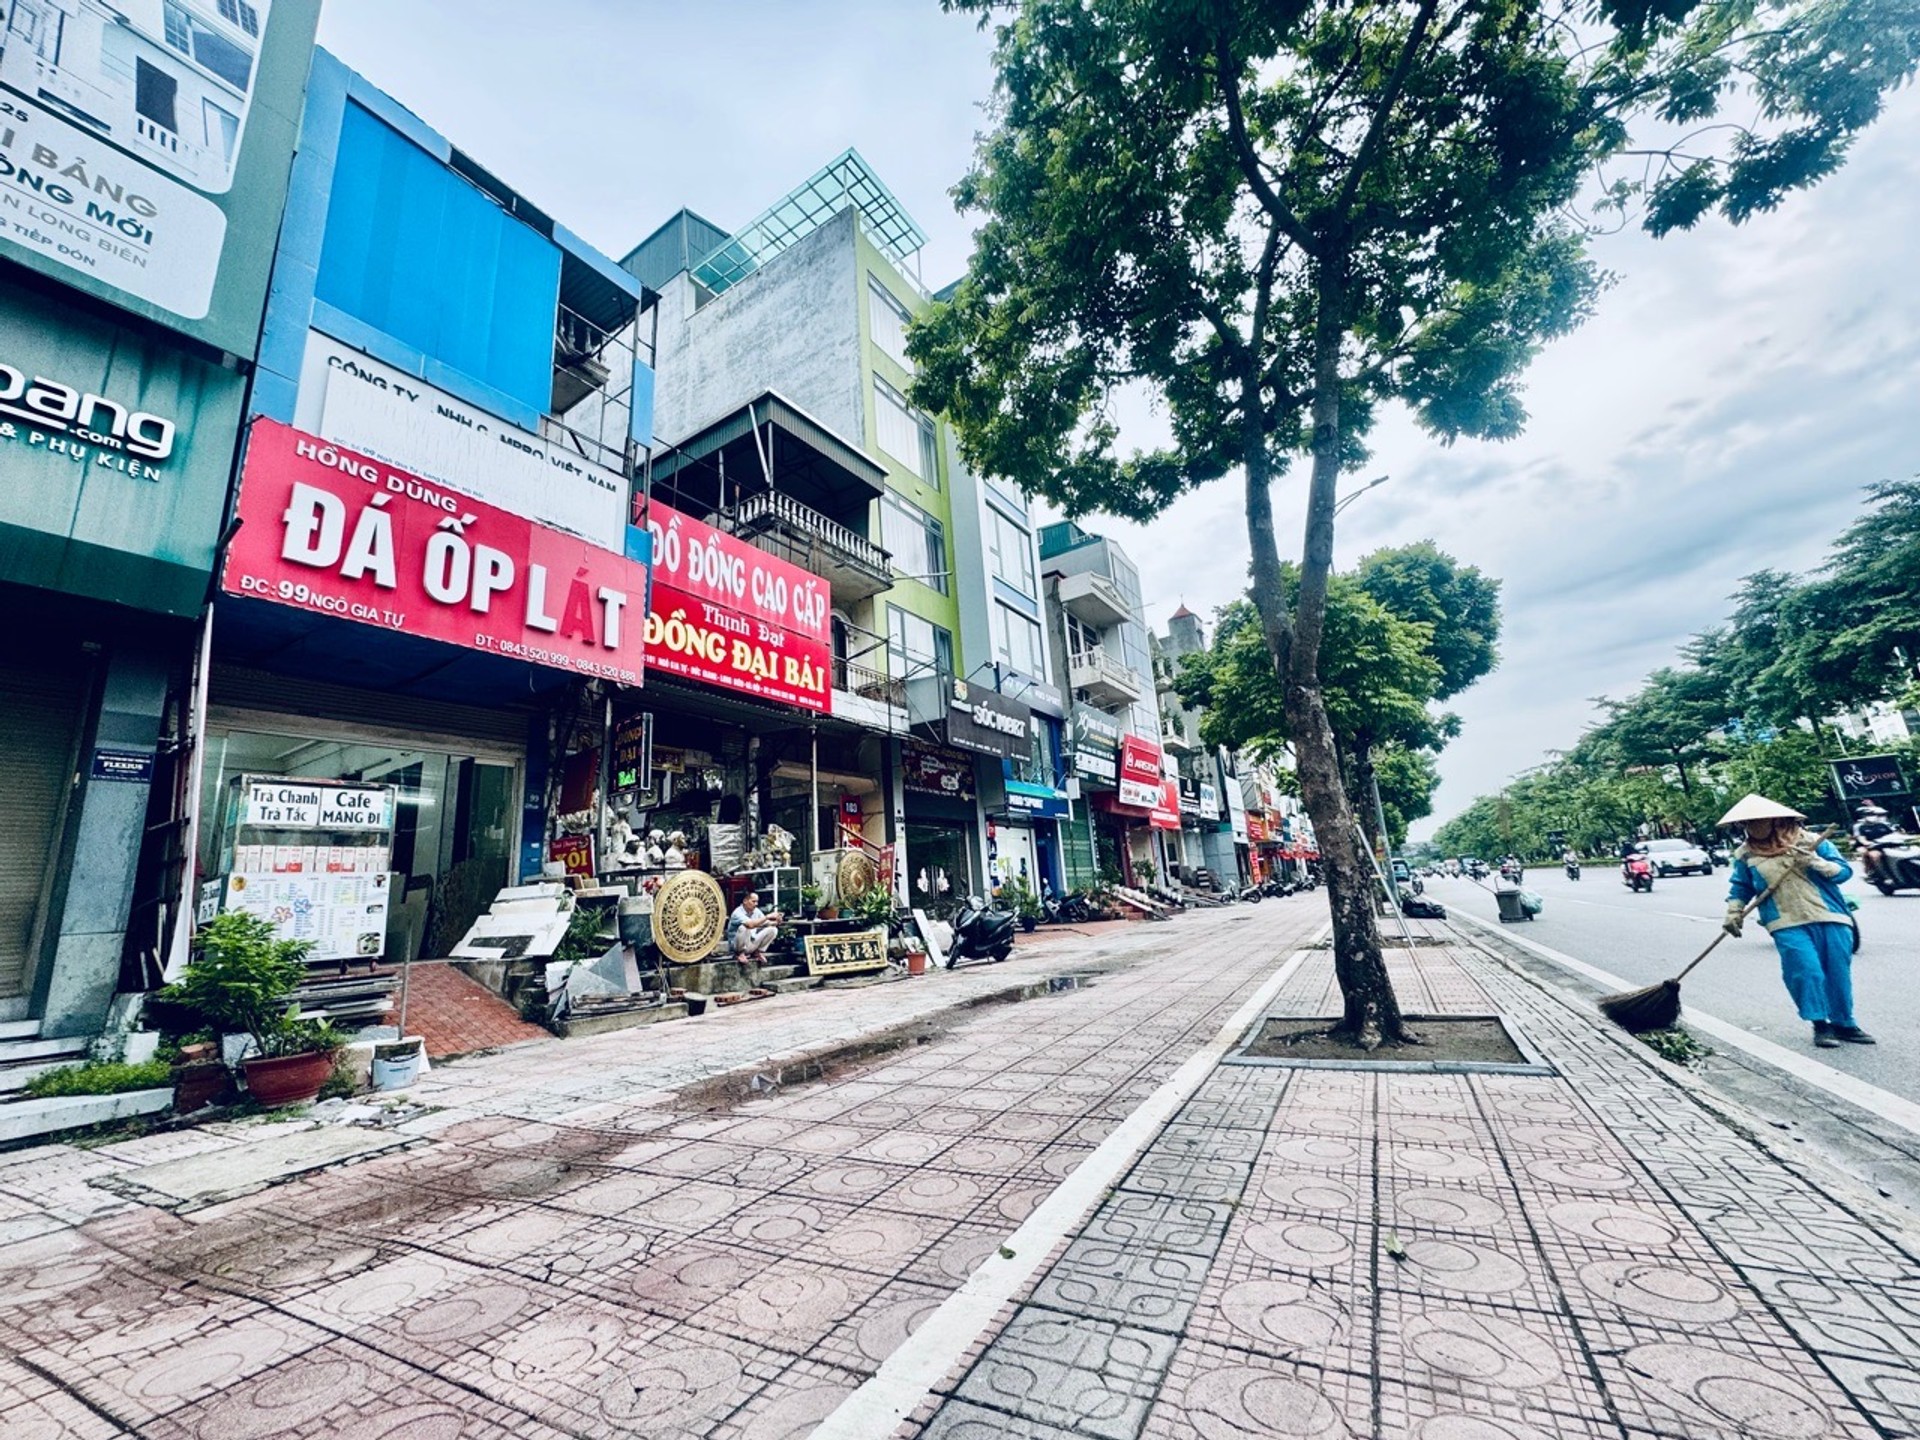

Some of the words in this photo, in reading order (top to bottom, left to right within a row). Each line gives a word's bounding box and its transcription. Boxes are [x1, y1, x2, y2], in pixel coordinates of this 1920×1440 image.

[32, 143, 157, 218] BẢNG
[13, 222, 53, 246] TIẾP
[57, 243, 96, 267] ĐÓN
[28, 205, 91, 243] LONG
[98, 238, 147, 268] BIÊN
[86, 201, 153, 245] MỚI
[30, 432, 85, 461] PHỤ
[98, 452, 161, 482] KIỆN
[295, 439, 379, 484] HỒNG
[387, 475, 458, 514] DŨNG
[281, 482, 397, 590] ĐÁ
[422, 513, 515, 614] ỐP
[525, 562, 627, 649] LÁT
[648, 514, 682, 573] ĐỒ
[687, 532, 745, 599] ĐỒNG
[751, 566, 787, 615] CAO
[792, 579, 825, 630] CẤP
[278, 580, 310, 603] 99
[310, 592, 348, 613] NGÔ
[351, 603, 379, 621] GIA
[383, 610, 405, 628] TỰ
[701, 603, 750, 637] Thịnh
[757, 623, 785, 649] Đạt
[500, 640, 527, 656] 0843
[529, 649, 548, 662] 520
[550, 652, 569, 666] 999
[643, 608, 727, 664] ĐỒNG
[731, 639, 779, 682] ĐẠI
[252, 788, 273, 803] Trà
[278, 789, 318, 805] Chanh
[260, 806, 281, 821] Trà
[286, 807, 307, 822] Tắc
[322, 810, 363, 824] MANG
[367, 812, 381, 825] ĐI
[336, 791, 371, 808] Cafe
